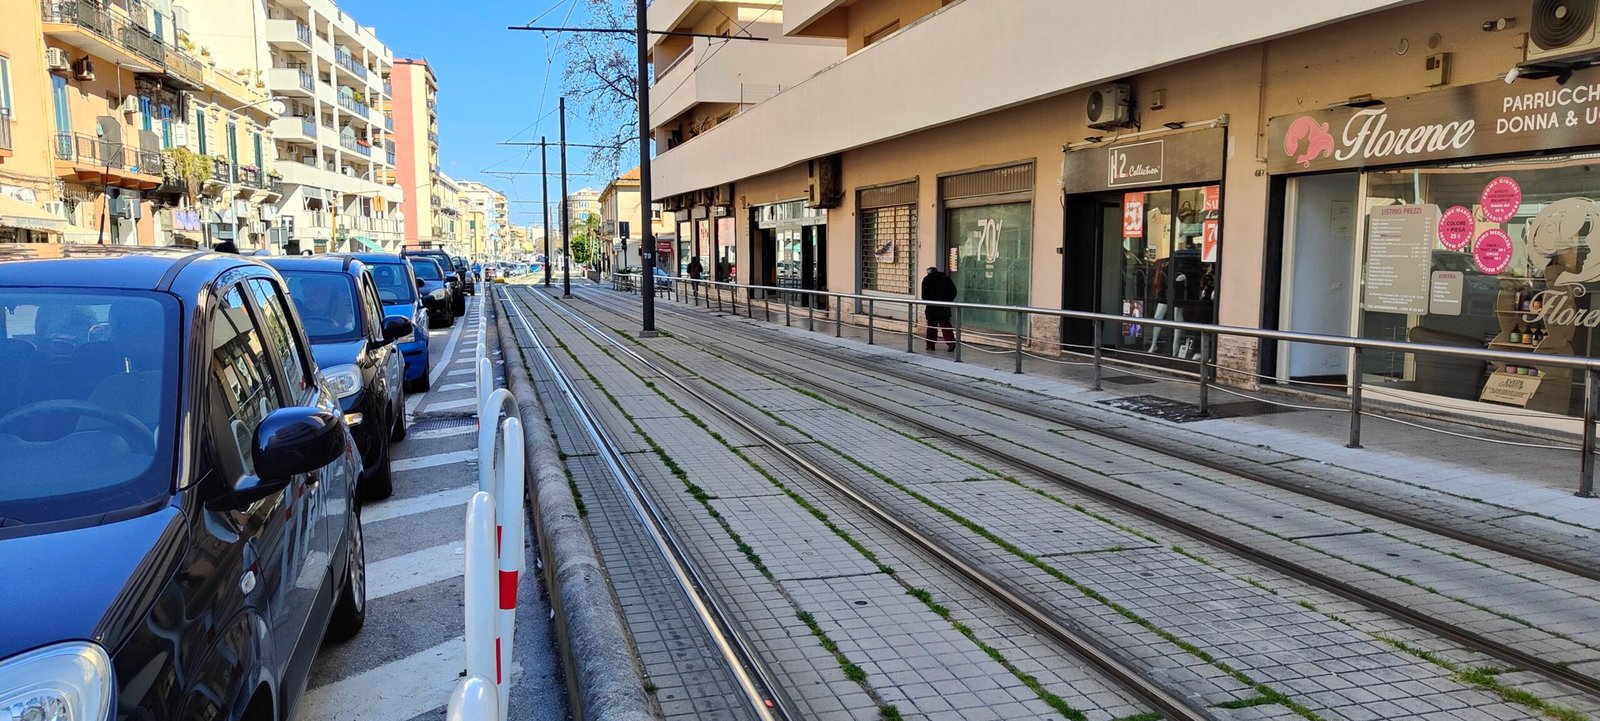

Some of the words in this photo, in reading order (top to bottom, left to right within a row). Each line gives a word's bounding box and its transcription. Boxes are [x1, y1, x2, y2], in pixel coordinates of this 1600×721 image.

[1496, 111, 1559, 134] DONNA
[1565, 110, 1578, 127] &
[1585, 106, 1600, 124] U
[1334, 107, 1475, 161] Florence
[1129, 164, 1160, 177] Collection
[1381, 208, 1402, 216] LISTINO
[1402, 207, 1423, 215] PREZZI
